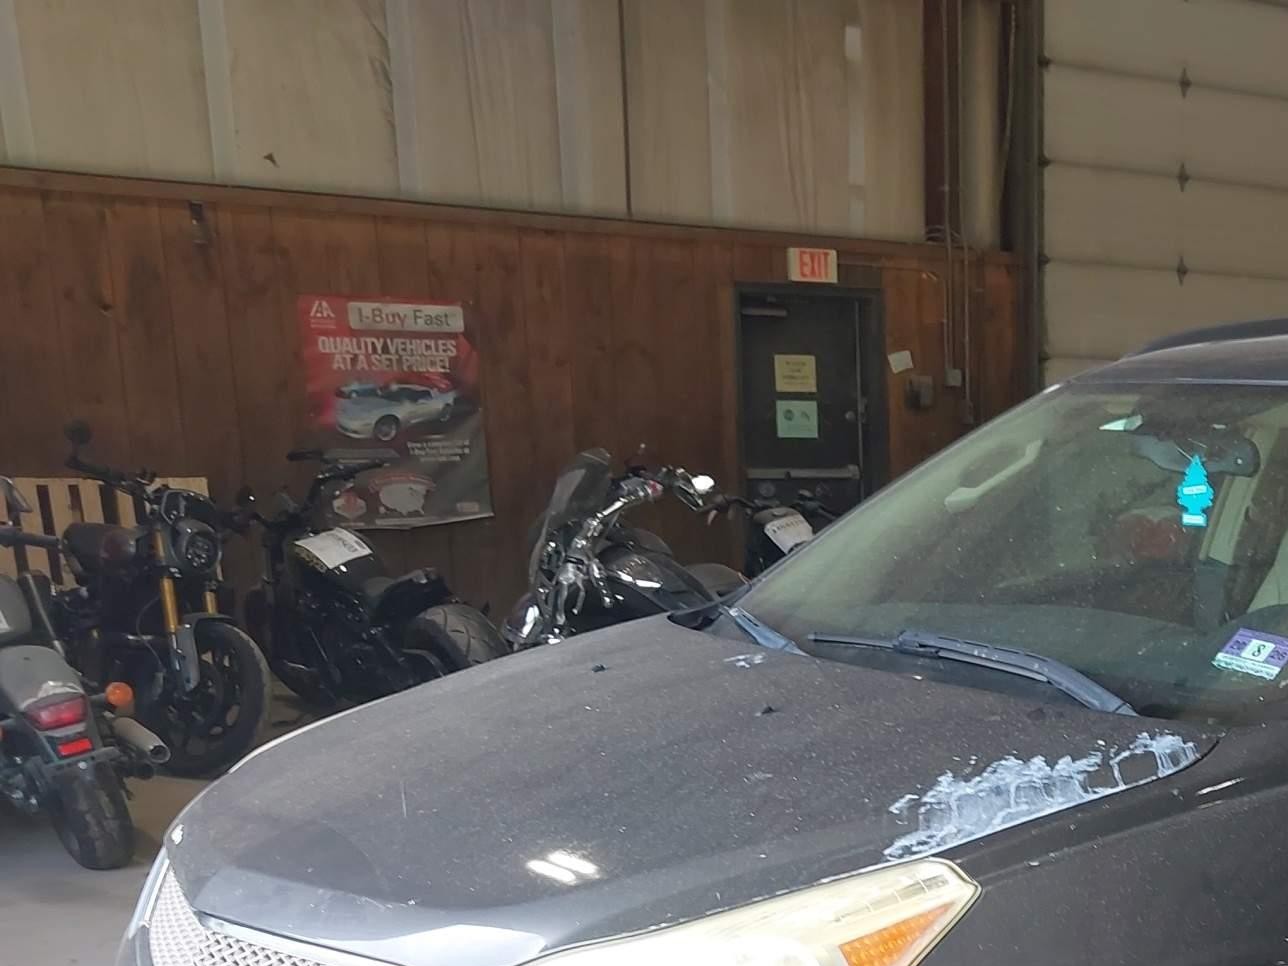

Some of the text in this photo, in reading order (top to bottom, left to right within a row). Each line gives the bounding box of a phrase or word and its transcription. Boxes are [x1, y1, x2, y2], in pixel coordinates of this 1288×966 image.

[800, 250, 830, 279] EXIT
[358, 306, 407, 328] I-Buy
[413, 309, 450, 328] Fast
[318, 336, 457, 357] QUALITY VEHICLES
[332, 354, 451, 373] AT A SET PRICE!
